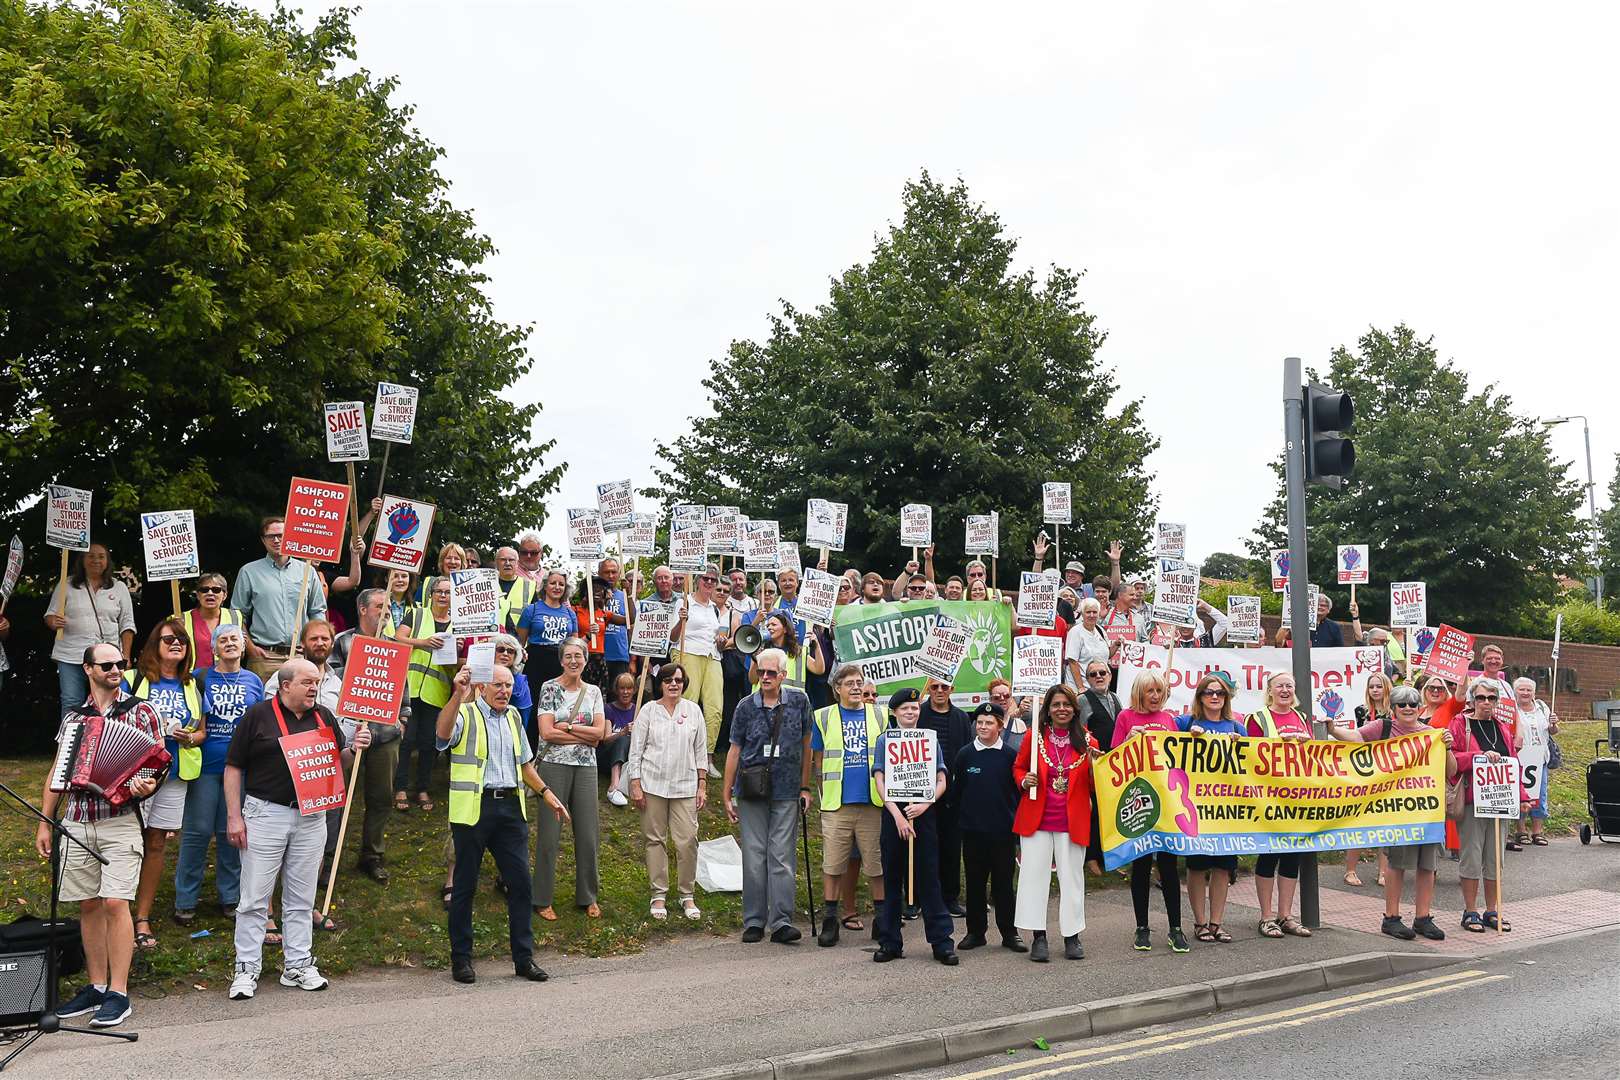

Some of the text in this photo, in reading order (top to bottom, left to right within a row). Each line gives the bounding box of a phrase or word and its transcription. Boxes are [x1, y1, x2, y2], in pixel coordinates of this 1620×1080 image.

[384, 385, 401, 395] NHS
[380, 397, 397, 405] SAVE
[388, 406, 413, 414] STROKE
[328, 410, 362, 432] SAVE
[380, 414, 411, 423] SERVICES
[338, 436, 361, 445] MATERNITY
[343, 442, 363, 450] SERVICES
[296, 486, 344, 500] ASHFORD
[52, 500, 84, 511] SAVE OUR
[314, 499, 323, 507] IS
[608, 497, 631, 509] STROKE
[294, 506, 339, 520] TOO FAR
[385, 502, 412, 516] HANDS
[603, 505, 632, 519] SERVICES
[61, 510, 87, 520] STROKE
[53, 519, 86, 529] SERVICES
[148, 515, 171, 527] NHS
[148, 523, 188, 540] SAVE OUR
[578, 527, 601, 536] STROKE
[717, 523, 738, 531] STROKE
[160, 533, 193, 547] STROKE
[573, 536, 601, 545] SERVICES
[711, 531, 737, 540] SERVICES
[682, 539, 705, 548] STROKE
[755, 538, 777, 547] STROKE
[153, 543, 193, 560] SERVICES
[296, 542, 335, 556] Labour
[395, 547, 416, 555] Thanet
[675, 548, 705, 557] SERVICES
[749, 546, 777, 556] SERVICES
[389, 557, 416, 566] Services
[392, 552, 413, 560] Health
[1165, 561, 1183, 571] NHS
[1161, 574, 1194, 584] SAVE OUR
[455, 581, 492, 596] SAVE OUR
[805, 581, 822, 590] SAVE
[1170, 584, 1196, 595] STROKE
[466, 591, 496, 604] STROKE
[812, 590, 835, 601] STROKE
[1031, 593, 1055, 601] STROKE
[1161, 594, 1194, 604] SERVICES
[1393, 588, 1423, 605] SAVE
[804, 597, 833, 608] SERVICES
[1024, 602, 1054, 610] SERVICES
[458, 601, 495, 616] SERVICES
[640, 613, 655, 622] SAVE
[938, 616, 957, 628] NHS
[544, 622, 568, 630] OUR
[646, 622, 670, 630] STROKE
[543, 629, 568, 640] NHS
[932, 628, 966, 644] SAVE OUR
[1447, 630, 1468, 642] QEQM
[937, 640, 964, 653] STROKE
[1441, 636, 1468, 649] STROKE
[364, 644, 398, 658] DON'T
[927, 647, 960, 663] SERVICES
[1018, 649, 1055, 659] SAVE OUR
[1439, 643, 1468, 656] SERVICE
[367, 656, 389, 667] KILL
[1028, 658, 1058, 666] STROKE
[1440, 652, 1460, 662] MUST
[1440, 658, 1458, 668] STAY
[365, 667, 387, 678] OUR
[862, 658, 903, 680] GREEN
[1020, 668, 1057, 677] SERVICES
[1242, 664, 1354, 689] Thnet
[354, 676, 395, 690] STROKE
[150, 689, 184, 701] SAVE
[211, 684, 246, 695] SAVE
[351, 688, 393, 702] SERVICE
[152, 699, 183, 709] OUR
[213, 694, 245, 704] OUR
[212, 704, 247, 716] NHS
[353, 704, 394, 718] Labour
[288, 742, 335, 758] SAVE OUR
[888, 739, 932, 765] SAVE
[297, 754, 333, 768] STROKE
[1109, 734, 1164, 787] SAVE
[1164, 737, 1250, 774] STROKE
[1255, 742, 1347, 777] SERVICE
[907, 762, 928, 771] STROKE
[300, 767, 336, 781] SERVICE
[898, 770, 928, 780] MATERNITY
[1476, 765, 1515, 786] SAVE
[904, 779, 930, 788] SERVICES
[312, 793, 342, 807] Labour
[1168, 768, 1436, 837] 3 EXCELLENT HOSPITALS FOR EAST KENT:
[1122, 796, 1151, 820] STOP
[1199, 796, 1439, 822] THANET, CANTERBURY, ASHFORD
[1134, 835, 1163, 854] NHS
[1224, 837, 1256, 851] LIVES
[1269, 835, 1314, 848] LISTEN
[1317, 834, 1335, 847] TO
[1338, 832, 1365, 845] THE
[1368, 827, 1425, 843] PEOPLE!
